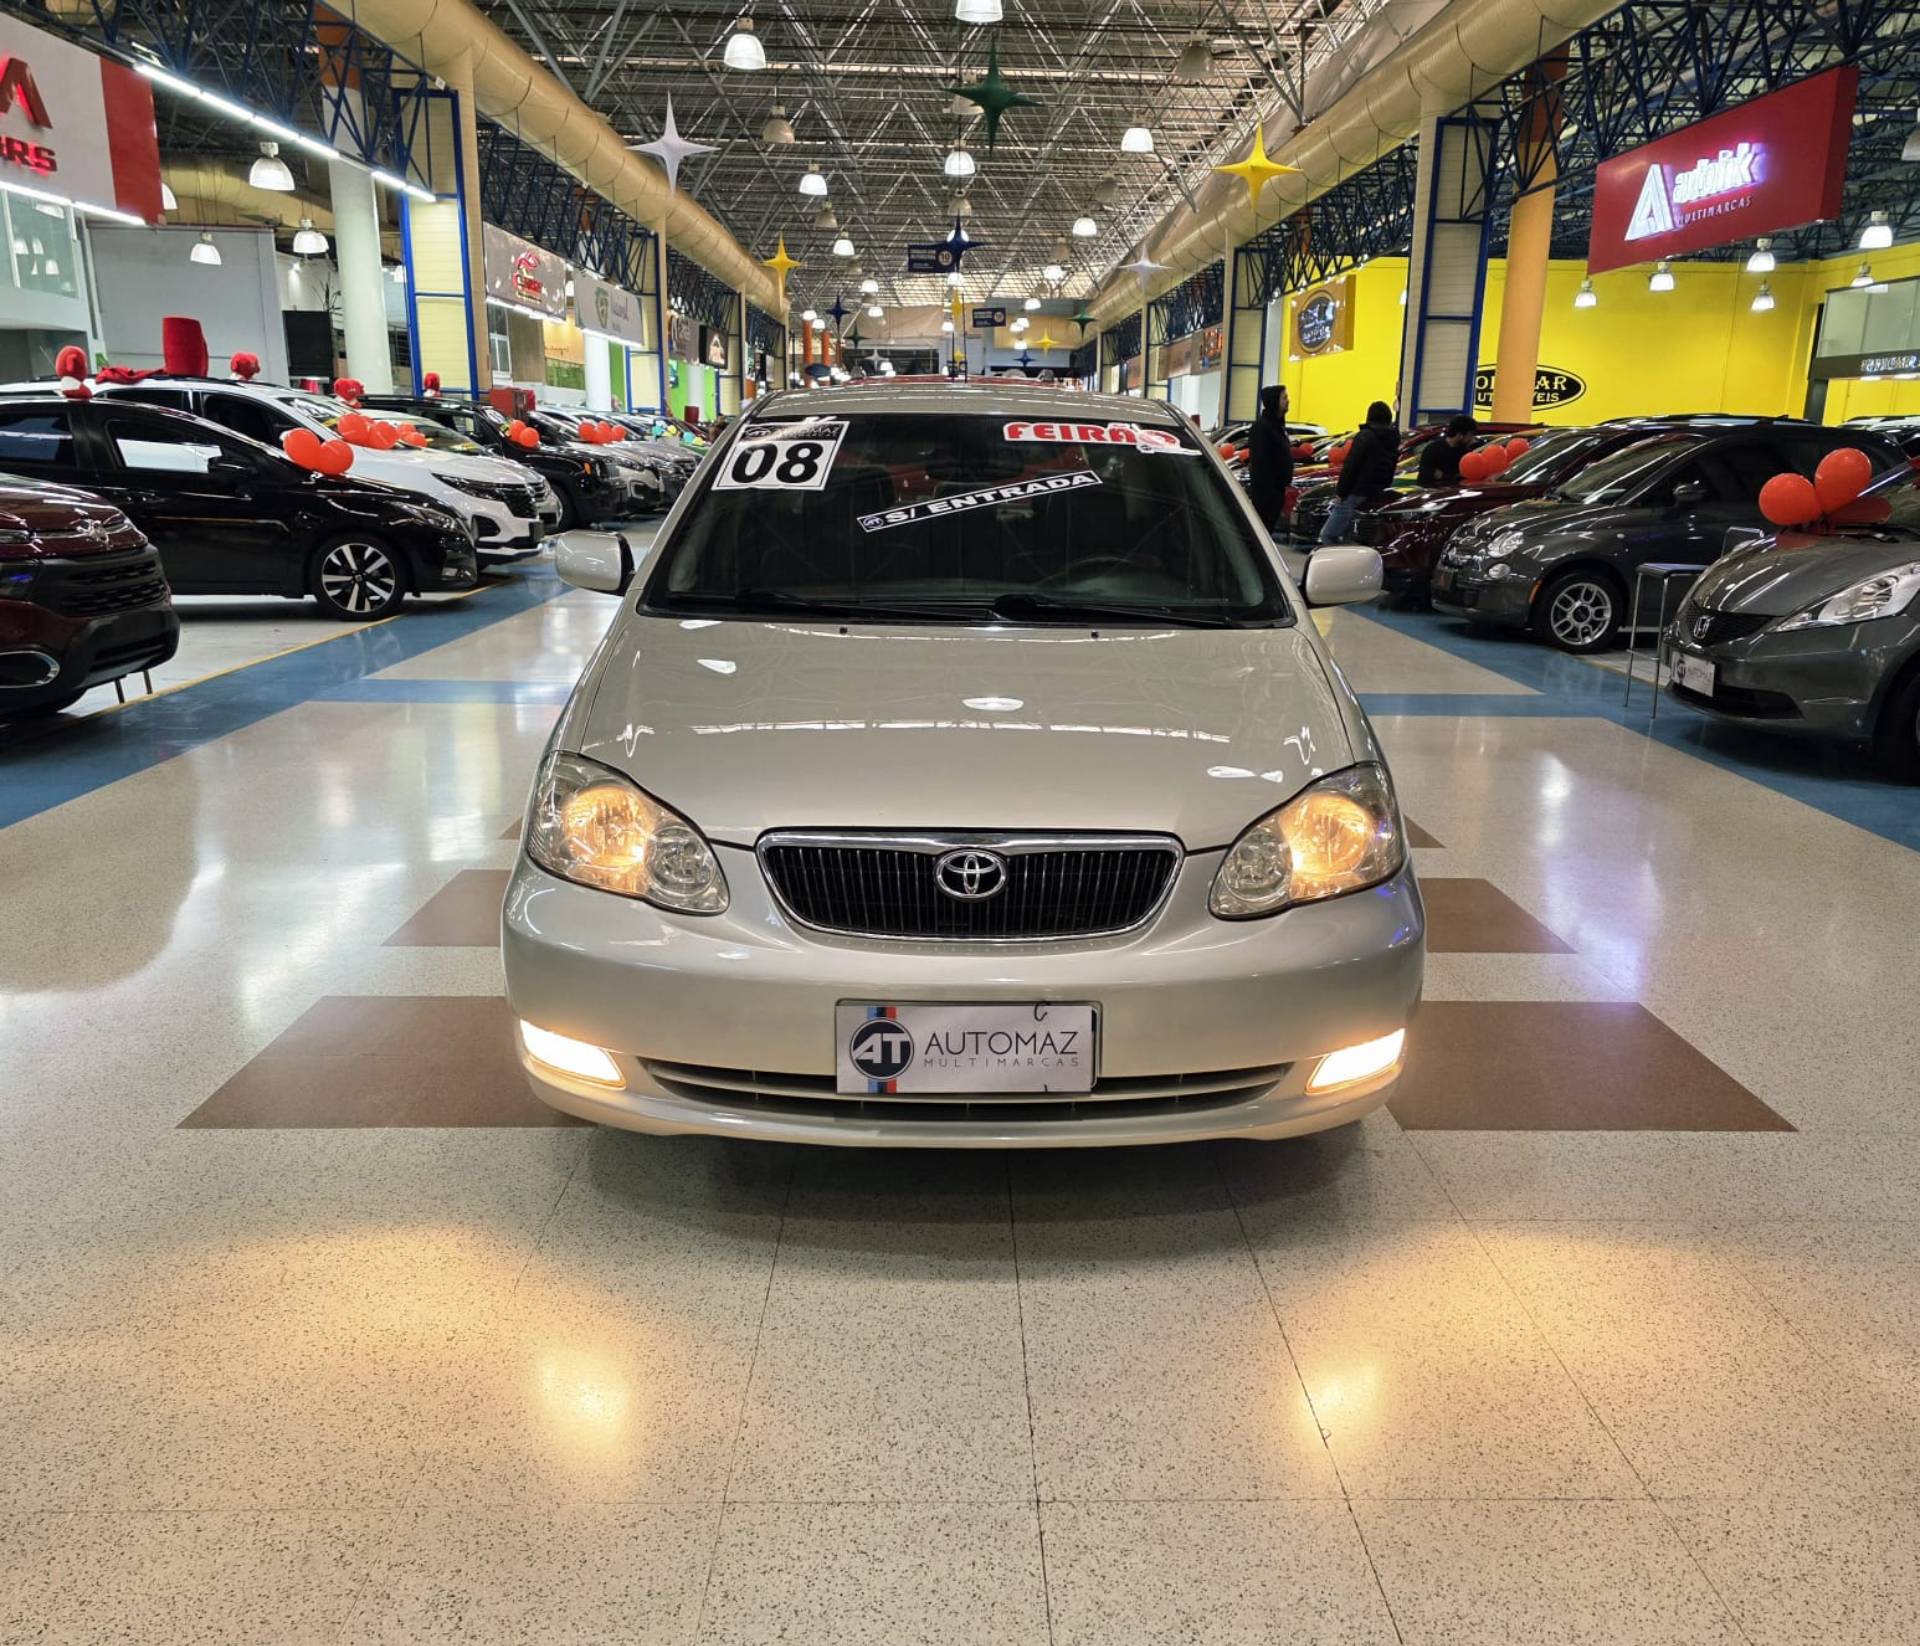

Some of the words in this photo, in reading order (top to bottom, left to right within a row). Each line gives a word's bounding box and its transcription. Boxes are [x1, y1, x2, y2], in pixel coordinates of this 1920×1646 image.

[731, 442, 823, 484] 08
[885, 507, 916, 524] S/
[927, 475, 1096, 514] ENTRADA
[853, 1032, 911, 1064] AT
[924, 1031, 1079, 1056] AUTOMAZ
[923, 1057, 1080, 1068] MULTIMARCAS
